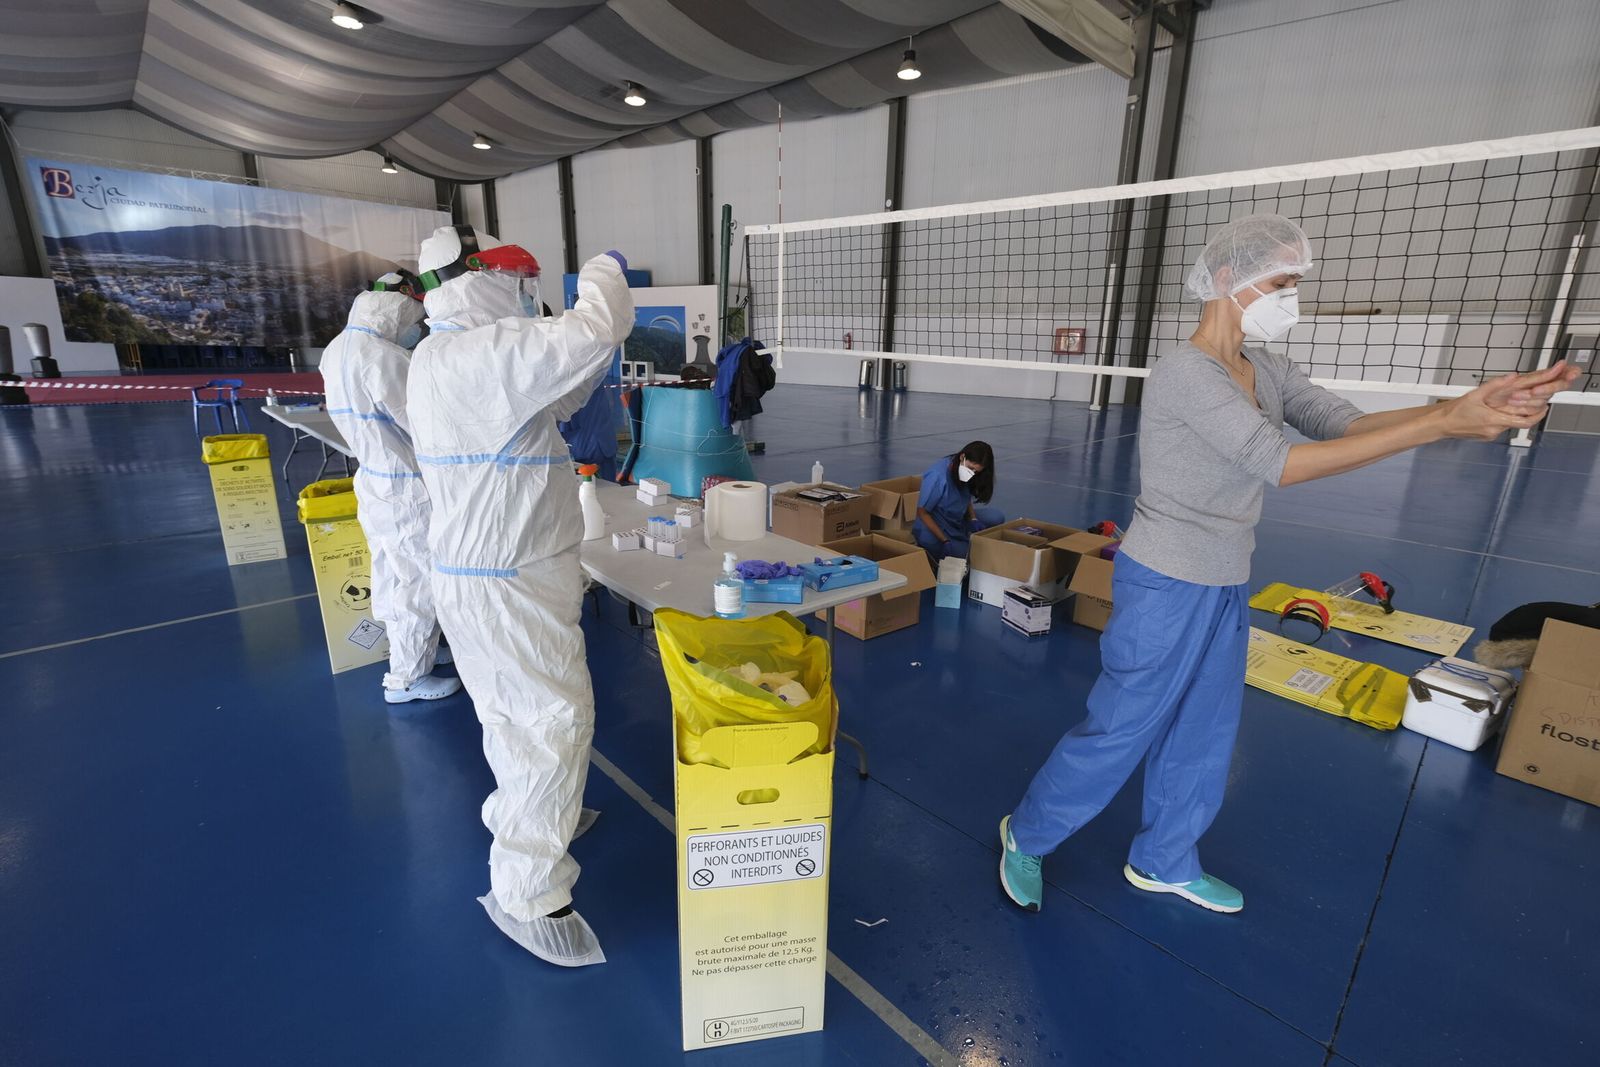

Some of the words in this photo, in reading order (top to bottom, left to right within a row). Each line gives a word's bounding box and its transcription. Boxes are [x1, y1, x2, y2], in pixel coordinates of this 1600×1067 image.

[110, 198, 146, 207] CIUDAD
[691, 837, 759, 853] PERFORANTS
[761, 836, 773, 847] ET
[776, 831, 822, 846] LIQUIDES
[704, 856, 729, 867] NON
[731, 847, 809, 865] CONDITIONNÉS
[731, 865, 783, 879] INTERDITS
[695, 948, 709, 956] est
[710, 945, 746, 955] autorisé
[748, 943, 769, 952] pour
[771, 939, 788, 948] une
[790, 936, 817, 945] masse
[724, 935, 739, 943] Cet
[741, 930, 788, 941] emballage
[697, 958, 721, 966] brute
[724, 952, 766, 963] maximale
[768, 950, 780, 958] de
[782, 947, 799, 956] 12,5
[801, 946, 814, 954] Kg.
[706, 967, 722, 976] pas
[723, 963, 762, 973] dépasser
[764, 960, 786, 968] cette
[788, 955, 817, 965] charge
